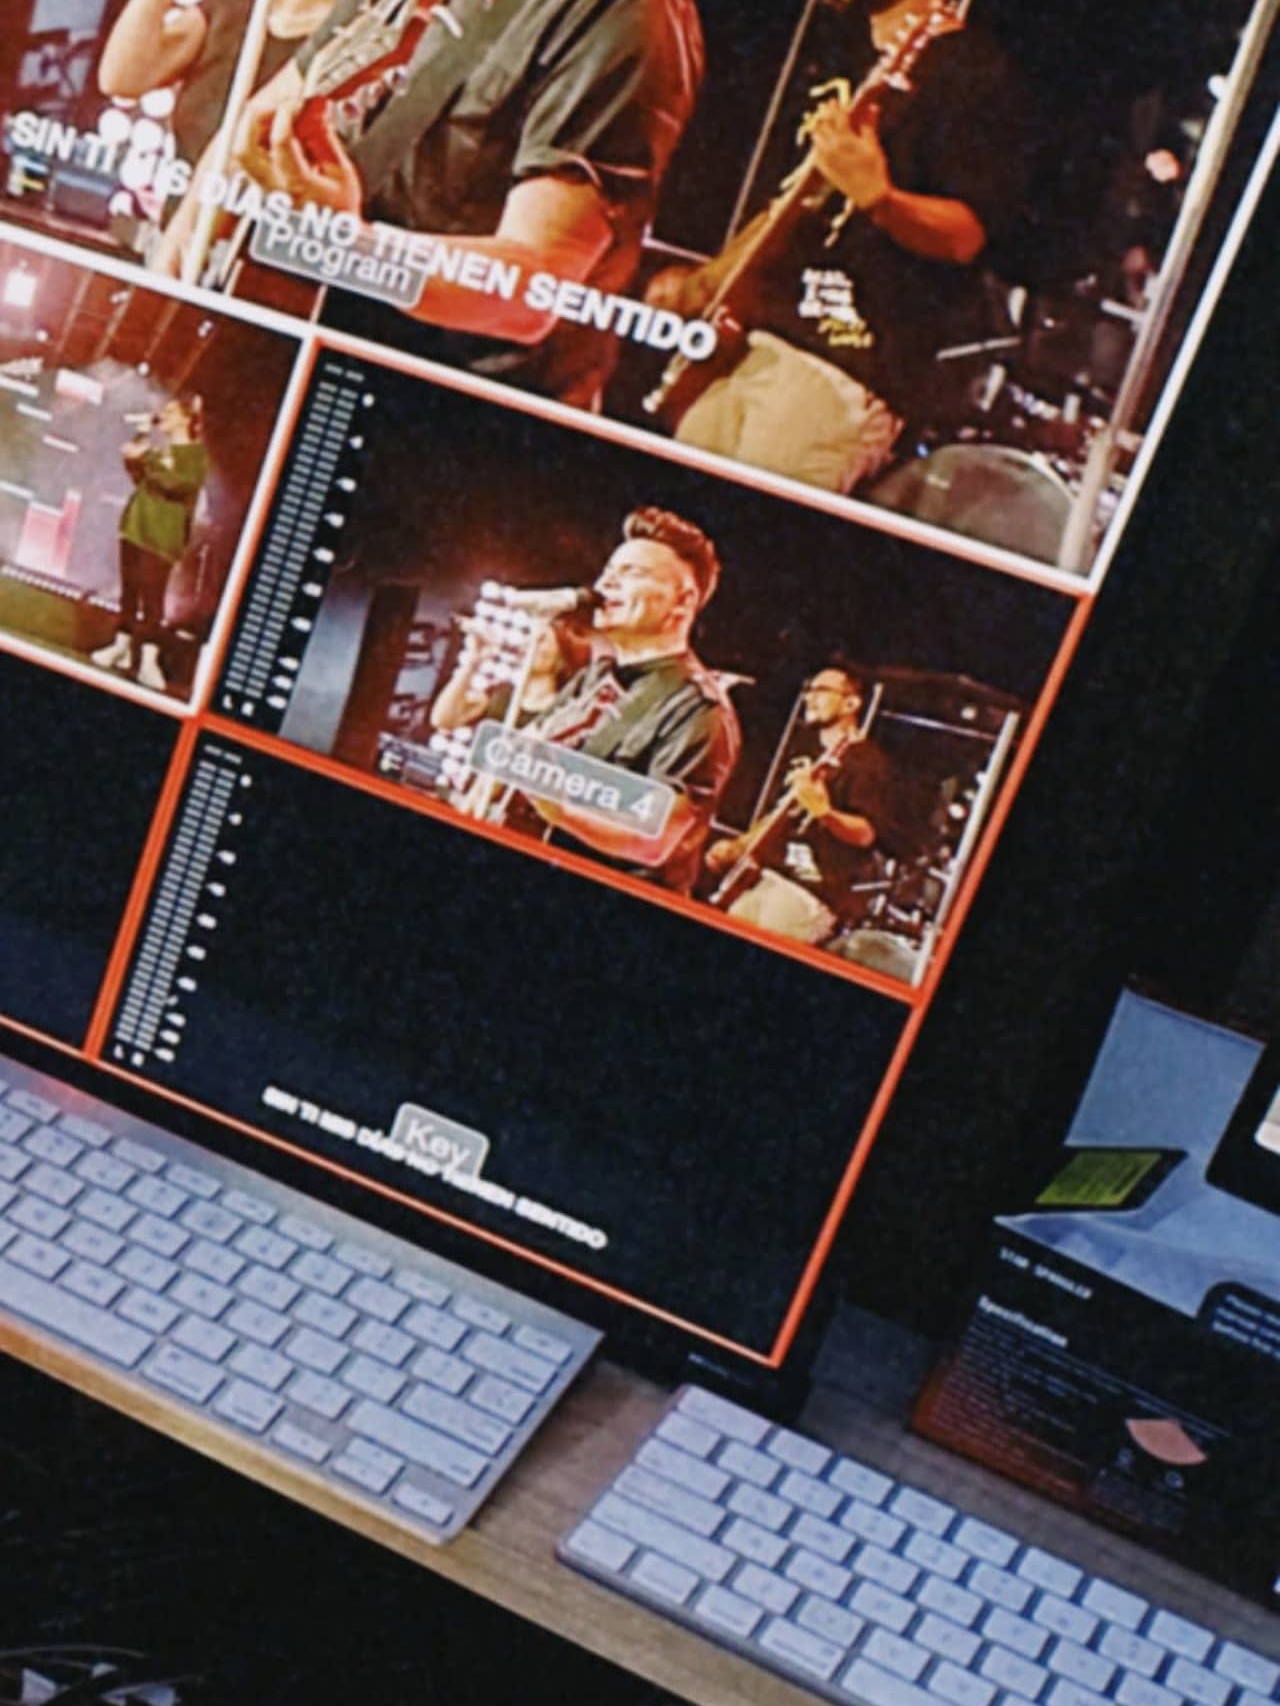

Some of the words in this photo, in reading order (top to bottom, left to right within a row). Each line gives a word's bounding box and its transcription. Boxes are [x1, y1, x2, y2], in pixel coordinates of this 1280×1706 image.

[9, 111, 74, 161] SIN
[74, 127, 113, 175] TI
[371, 221, 520, 300] TIENEN
[524, 272, 718, 362] SENTIDO
[263, 223, 412, 293] Program
[485, 736, 622, 812] Camera
[628, 783, 655, 822] 4
[407, 1117, 470, 1171] Key
